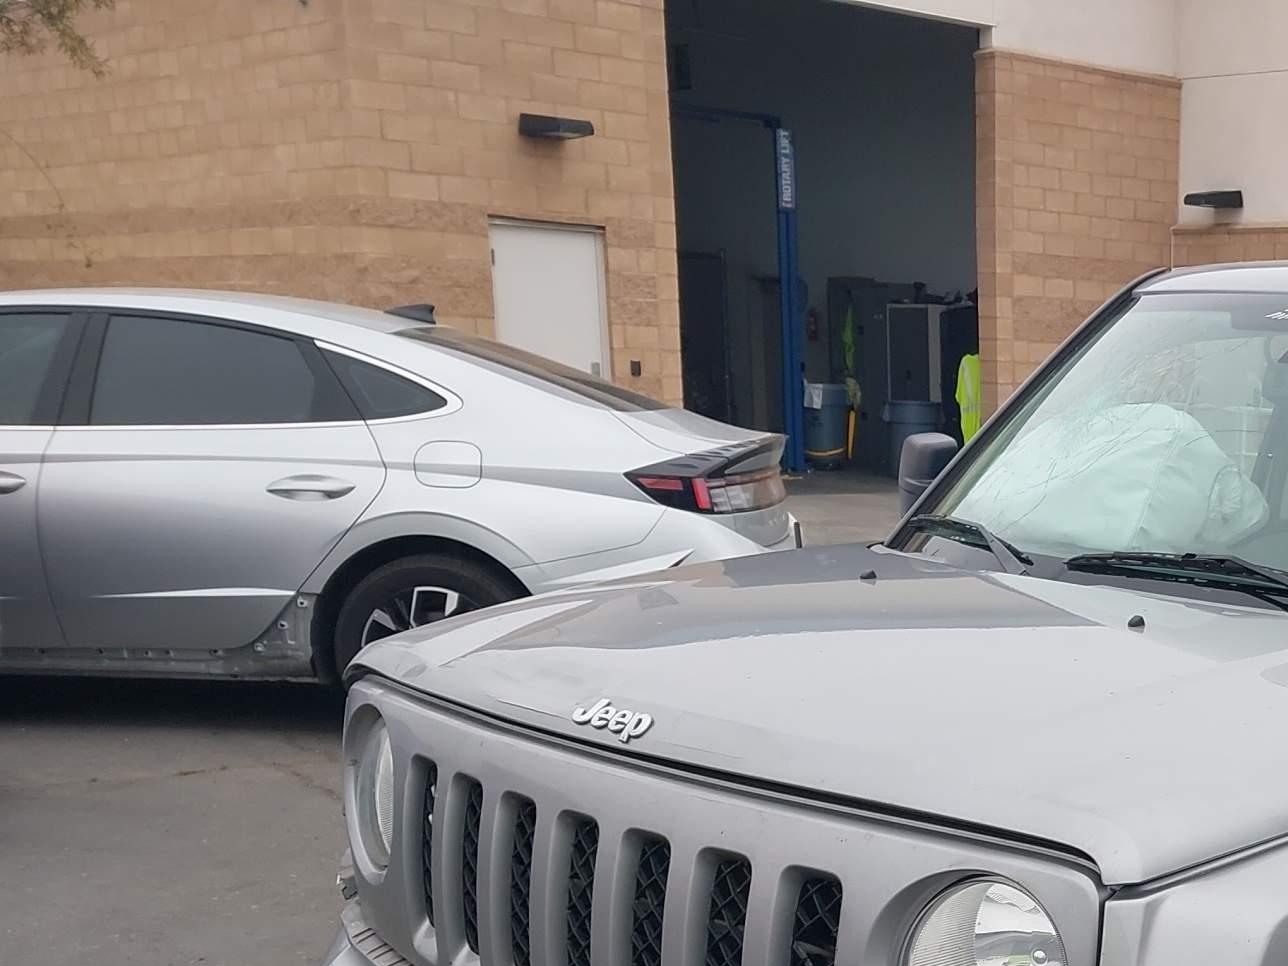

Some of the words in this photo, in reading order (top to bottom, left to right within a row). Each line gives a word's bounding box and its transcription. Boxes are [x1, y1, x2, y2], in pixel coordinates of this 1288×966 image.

[780, 129, 791, 154] LIFT
[780, 156, 792, 202] ROTARY
[571, 697, 654, 744] Jeep
